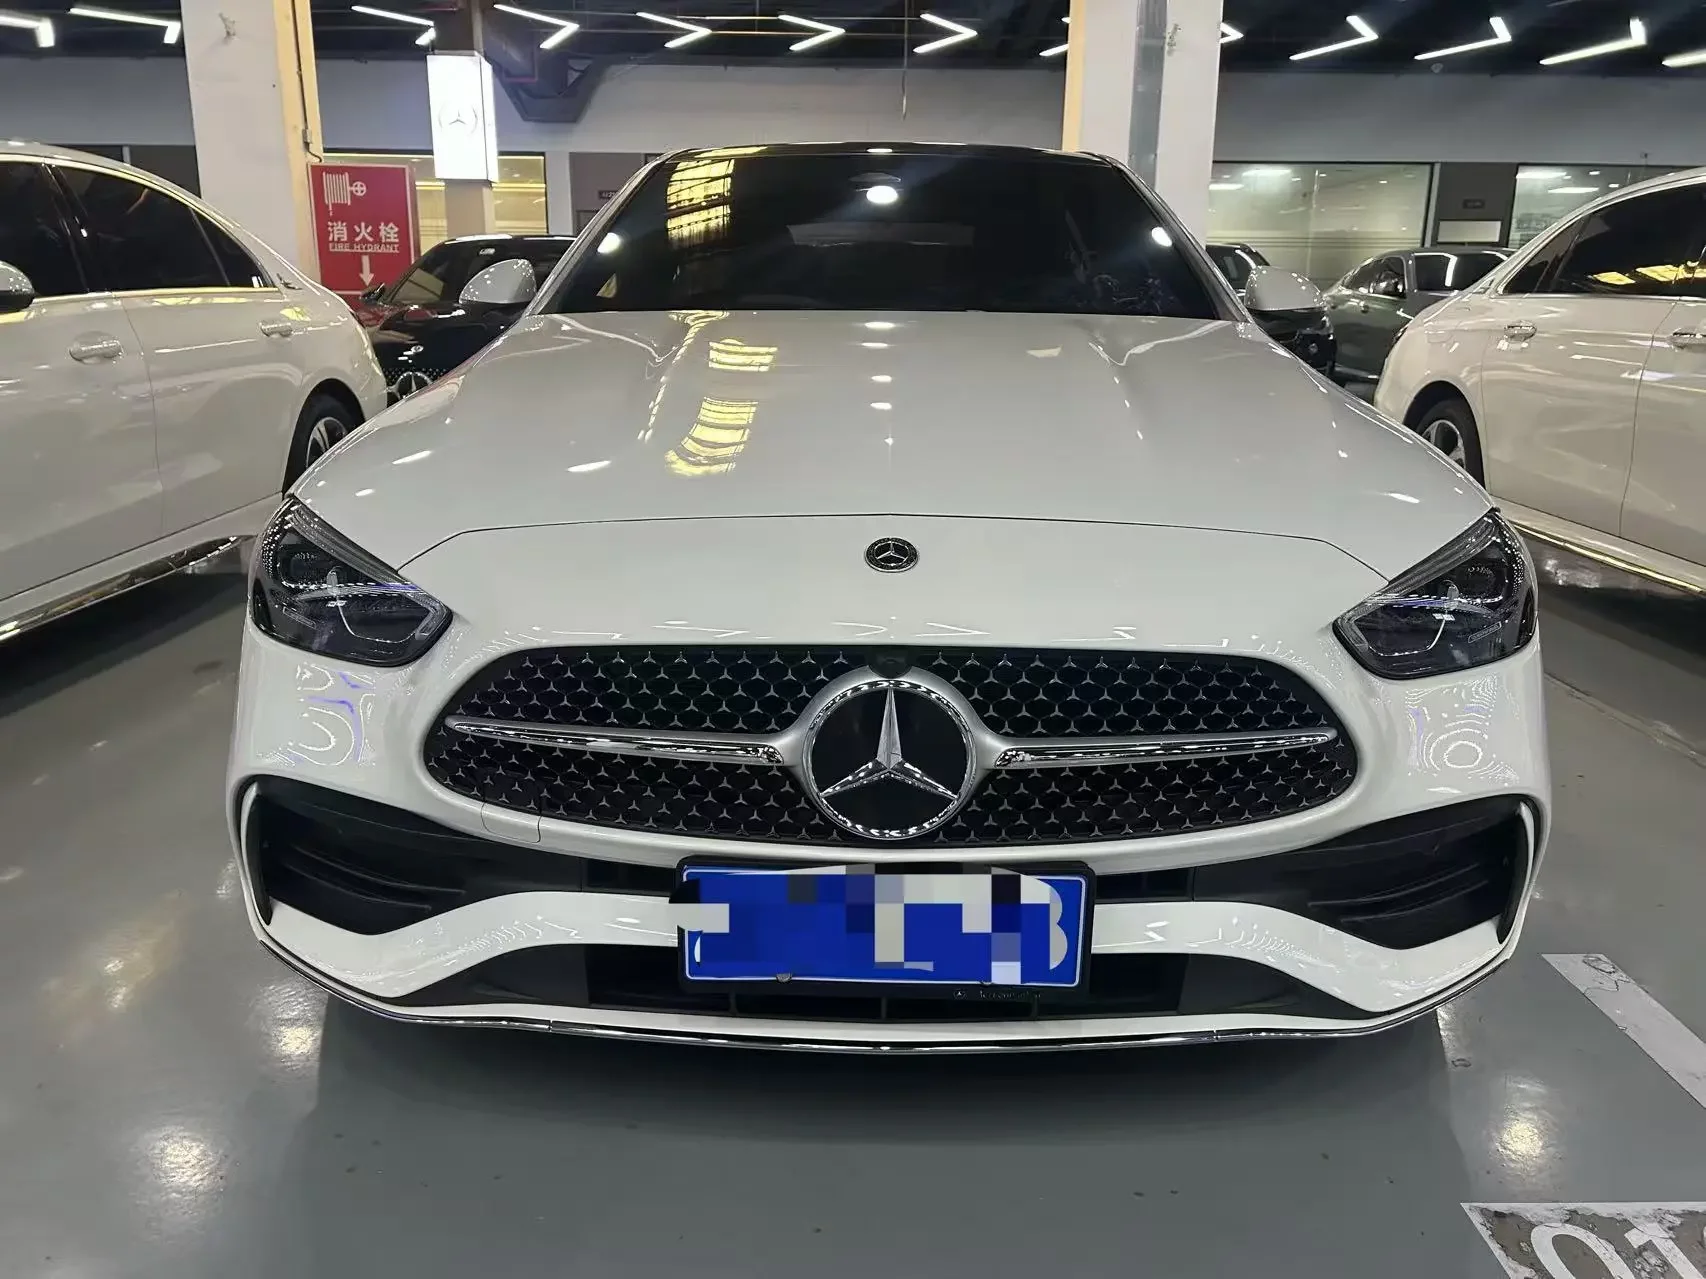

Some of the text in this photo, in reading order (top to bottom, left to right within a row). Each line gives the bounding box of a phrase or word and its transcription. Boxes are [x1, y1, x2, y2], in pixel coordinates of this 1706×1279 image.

[328, 221, 399, 242] 消火栓
[329, 243, 399, 253] FIRE HYDRANT
